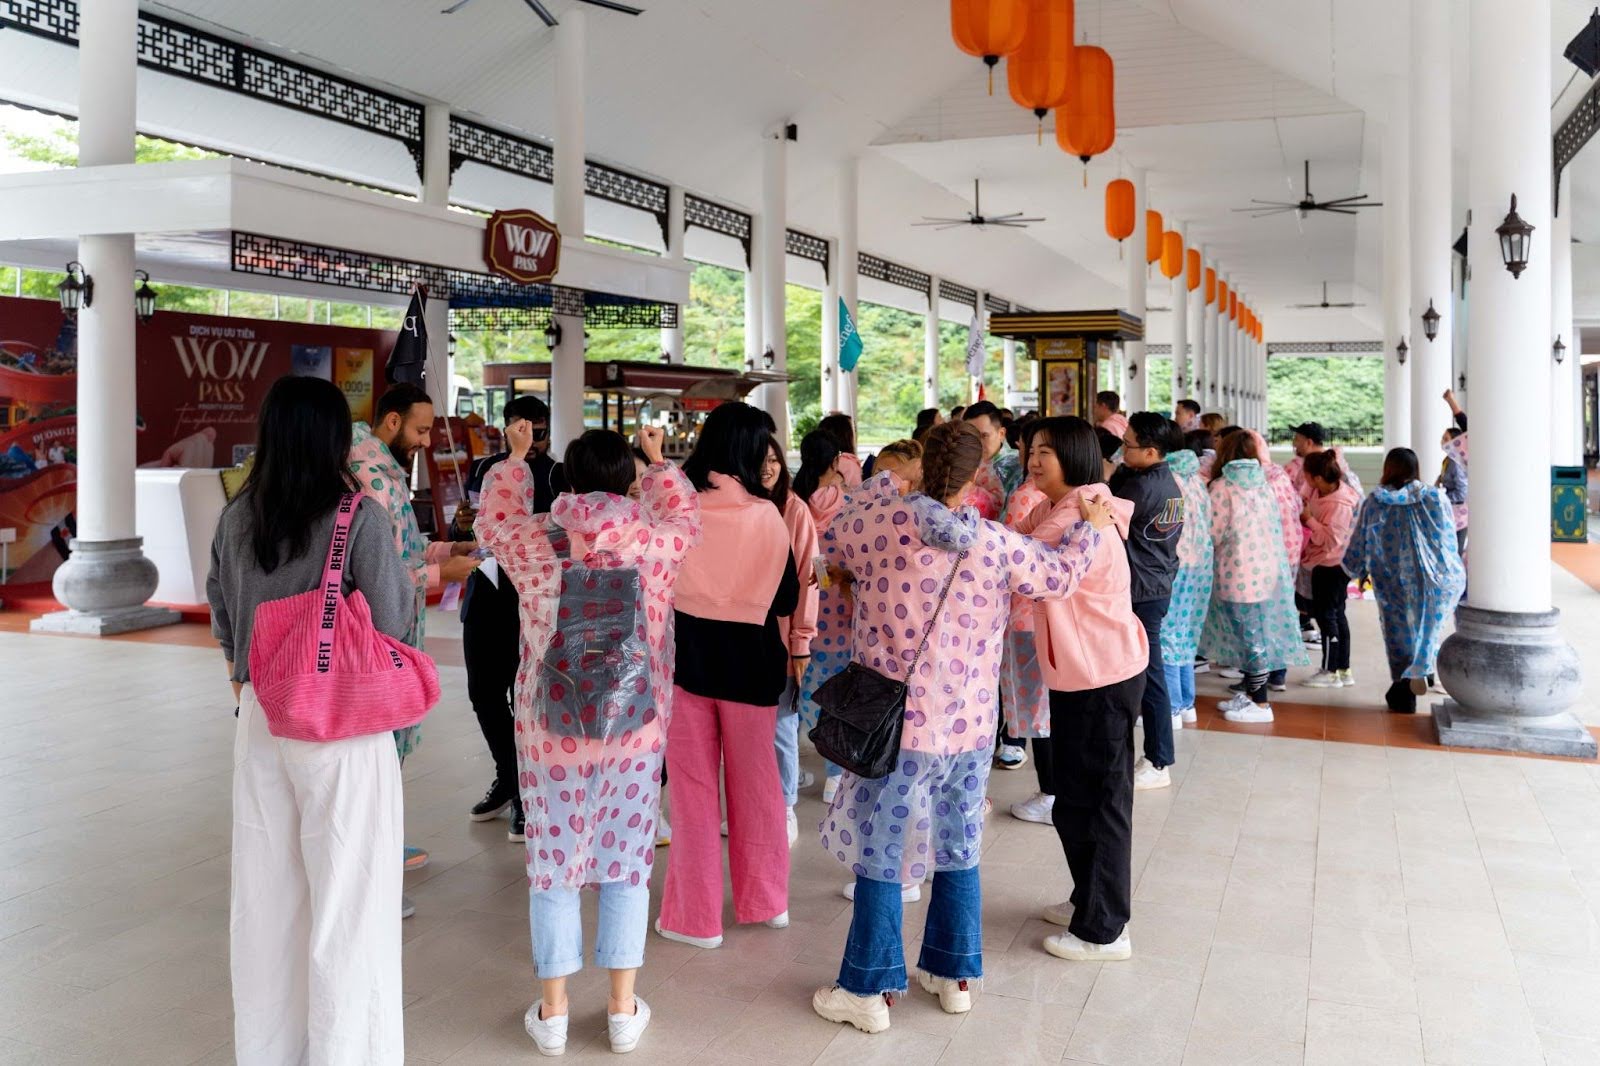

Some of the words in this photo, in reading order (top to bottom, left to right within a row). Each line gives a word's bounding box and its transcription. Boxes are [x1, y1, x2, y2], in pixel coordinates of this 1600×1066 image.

[503, 222, 553, 259] WOW
[512, 255, 538, 272] PASS
[171, 336, 271, 381] WOW
[199, 381, 245, 402] PASS
[330, 524, 348, 571] BENEFIT
[322, 582, 339, 629] BENEFIT
